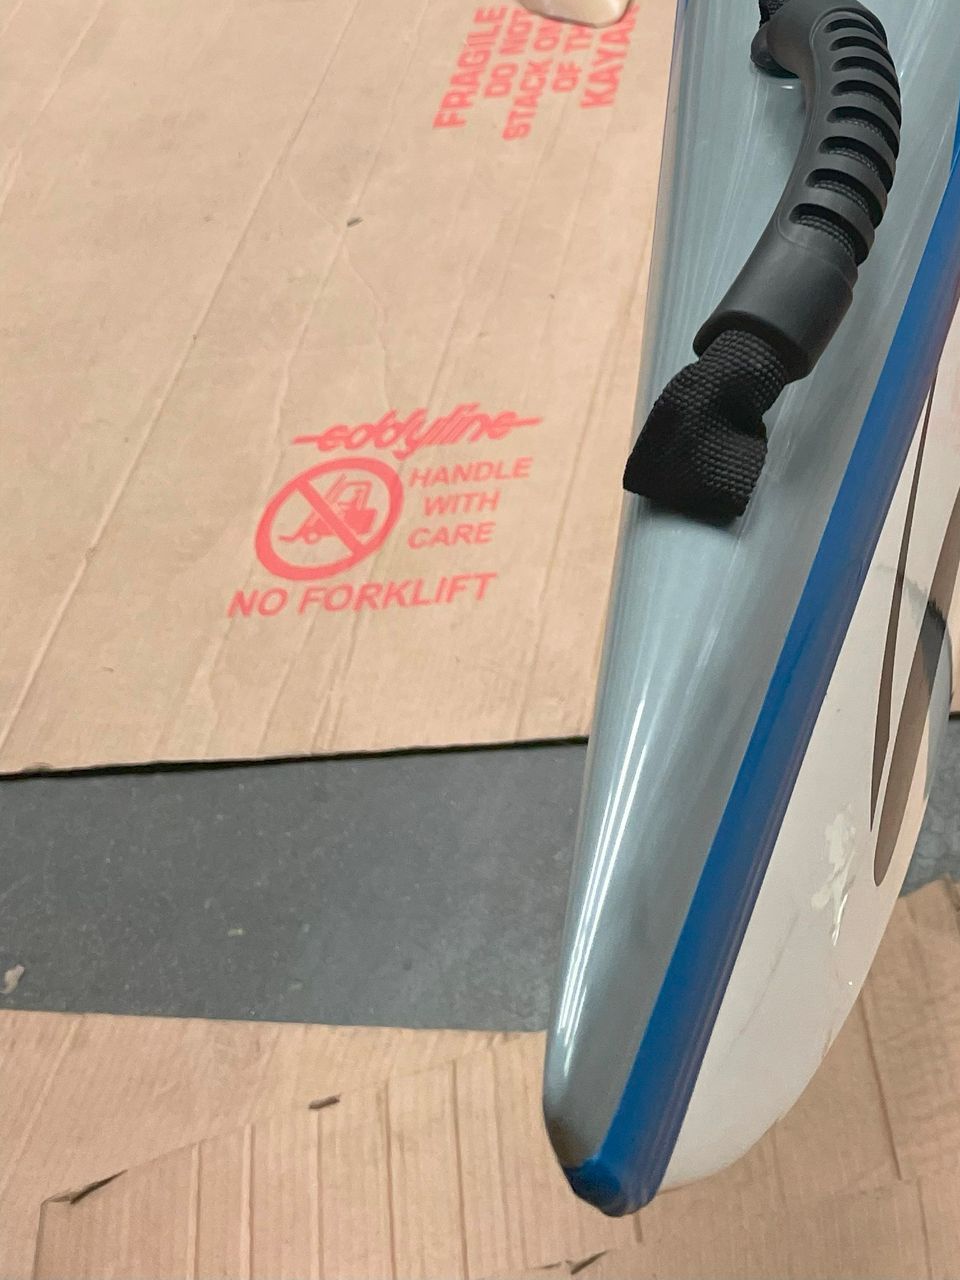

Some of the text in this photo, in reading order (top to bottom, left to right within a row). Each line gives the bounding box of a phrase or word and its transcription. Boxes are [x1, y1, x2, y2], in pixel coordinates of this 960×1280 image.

[433, 6, 507, 127] FRAGILE
[552, 25, 593, 94] OF TH
[581, 5, 638, 108] KAYA
[484, 64, 516, 97] DO
[503, 60, 551, 140] STACK
[408, 456, 533, 488] HANDLE
[423, 489, 500, 518] WITH
[407, 521, 496, 550] CARE
[227, 572, 497, 618] NO FORKLIFT
